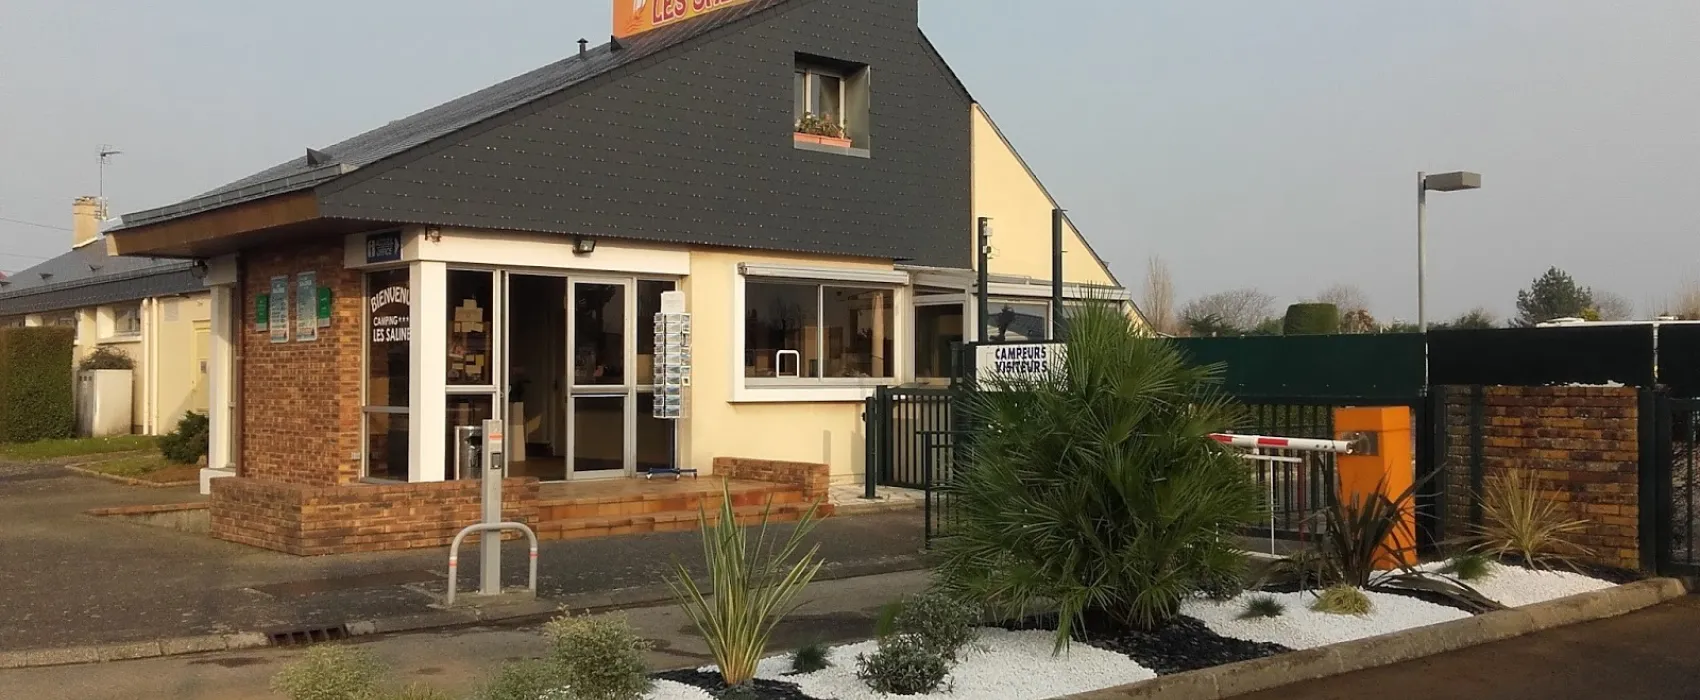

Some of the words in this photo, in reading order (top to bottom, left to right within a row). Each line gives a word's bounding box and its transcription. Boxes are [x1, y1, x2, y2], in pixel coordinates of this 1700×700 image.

[651, 0, 687, 24] LES
[373, 316, 398, 327] CAMPING
[373, 328, 385, 342] LES
[995, 347, 1046, 360] CAMPEURS
[995, 361, 1047, 373] VISITEURS
